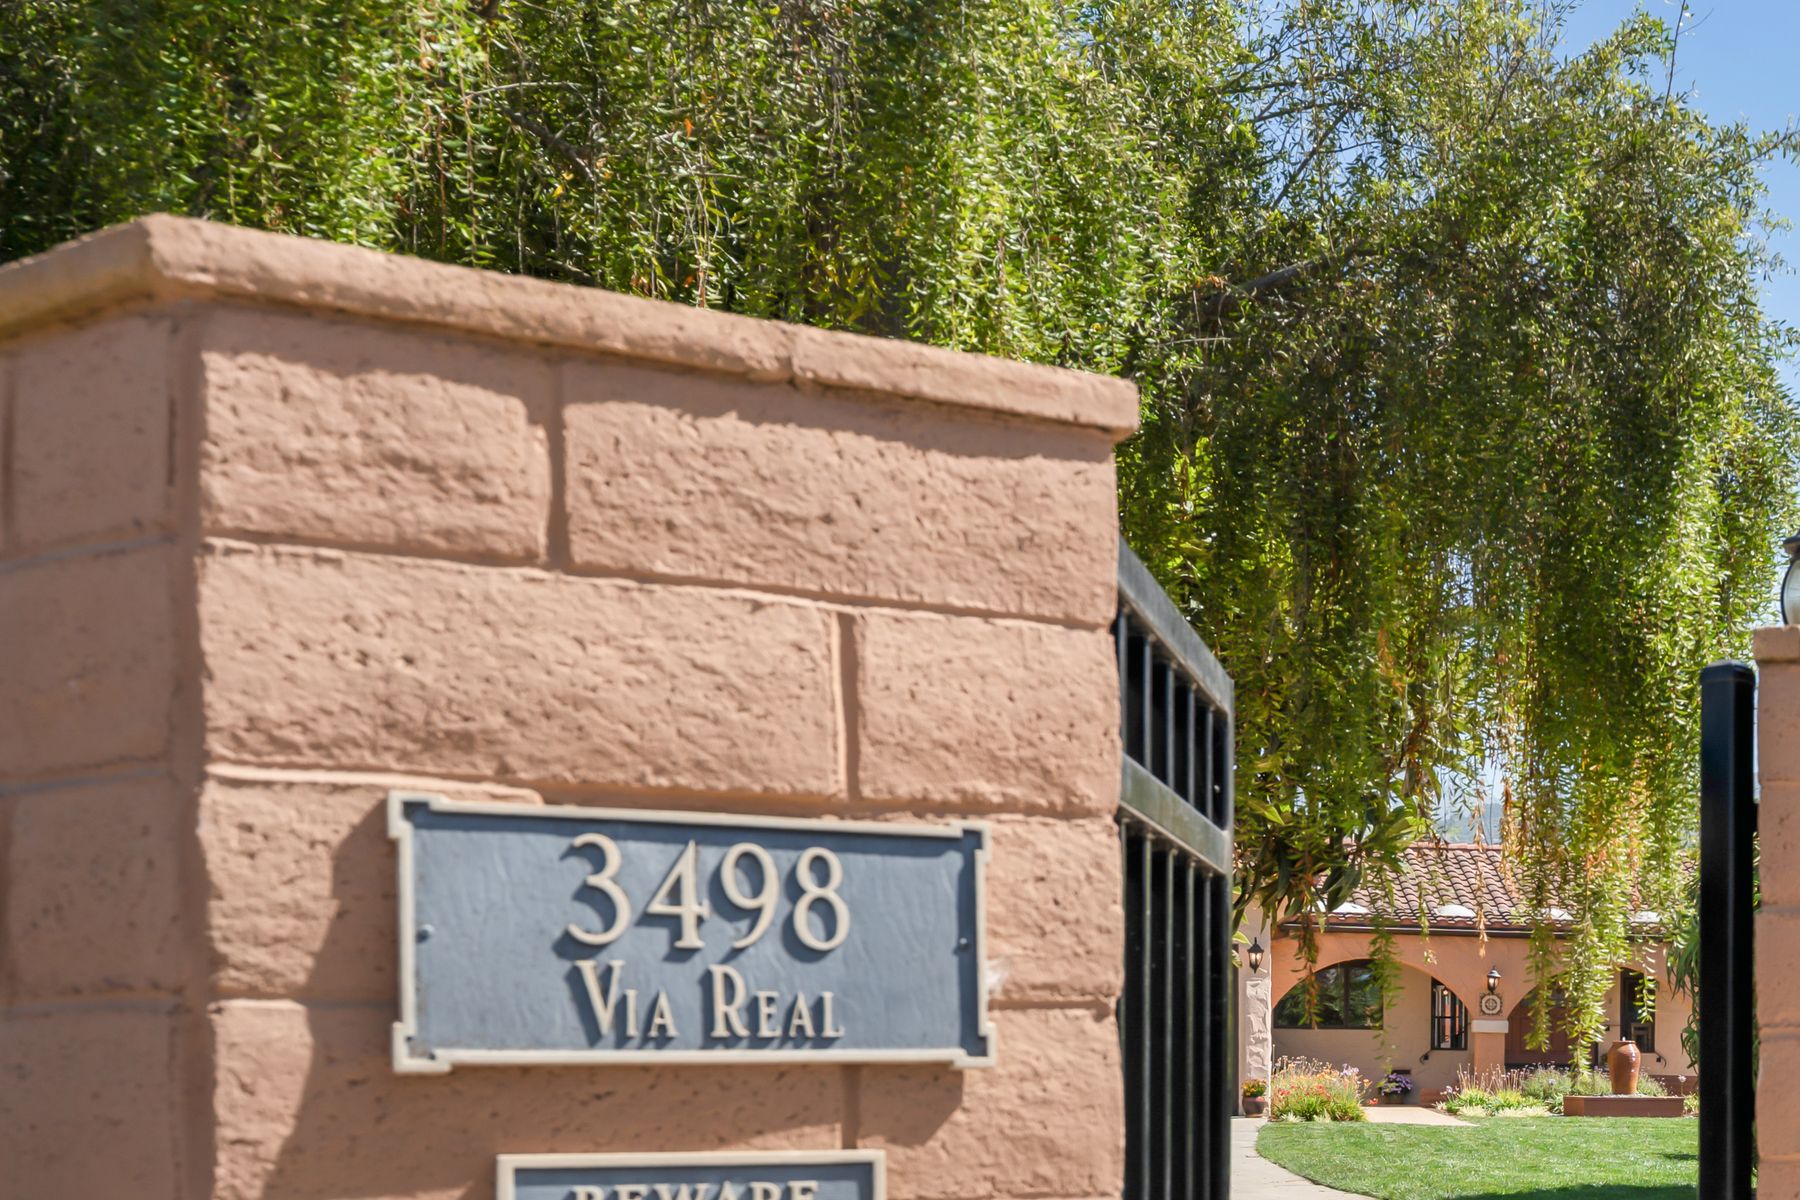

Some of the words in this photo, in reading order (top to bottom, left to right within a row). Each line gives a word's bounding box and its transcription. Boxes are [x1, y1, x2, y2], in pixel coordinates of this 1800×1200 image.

[566, 832, 850, 952] 3498
[573, 959, 679, 1039] VIA
[708, 963, 846, 1039] REAL
